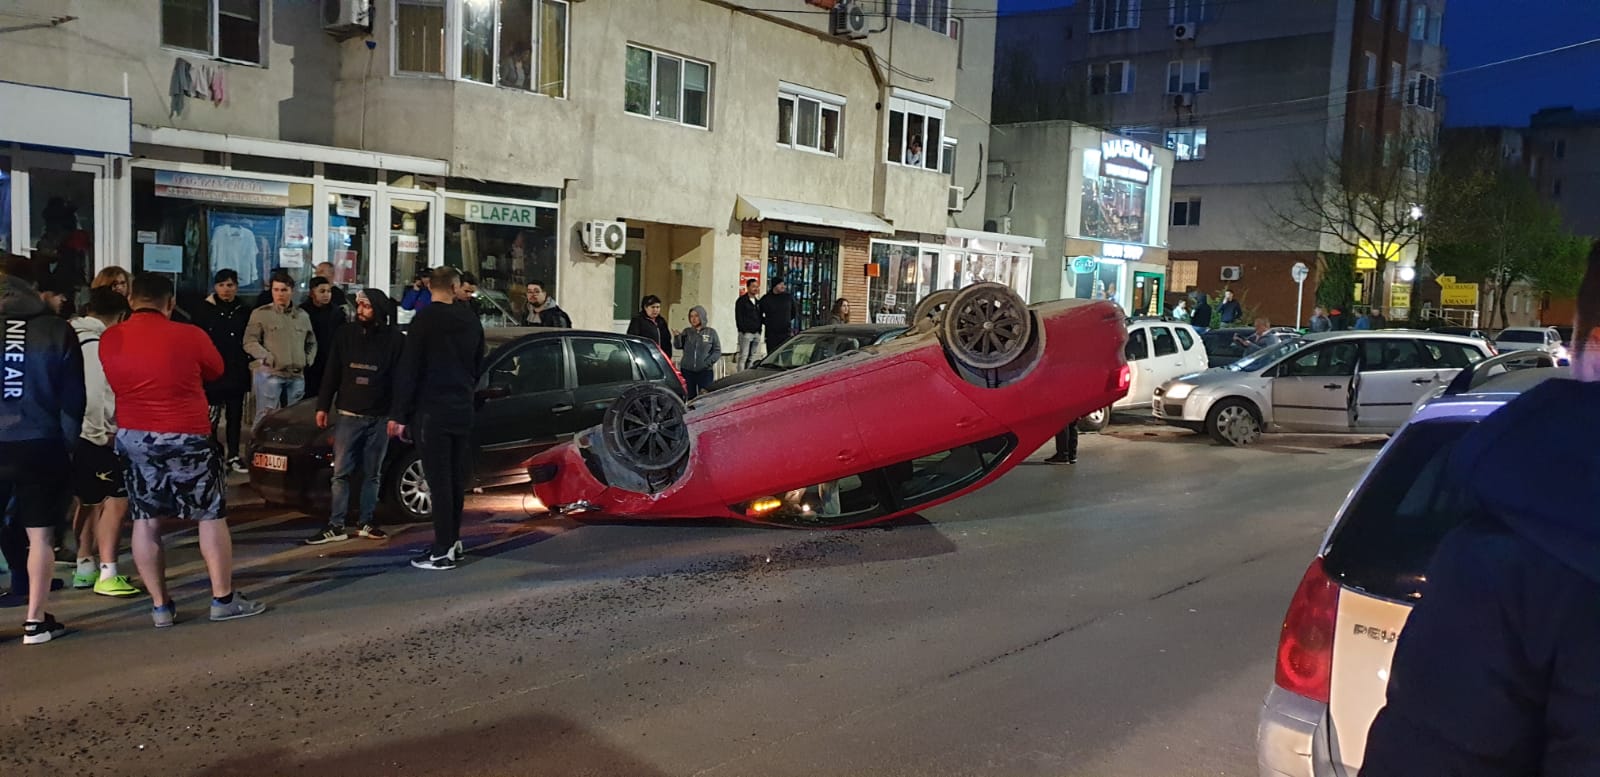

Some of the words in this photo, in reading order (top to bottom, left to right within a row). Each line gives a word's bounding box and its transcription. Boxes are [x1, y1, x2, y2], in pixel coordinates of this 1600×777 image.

[1102, 139, 1154, 171] MAGNUM
[470, 204, 531, 223] PLAFAR
[5, 320, 26, 362] NIKE
[4, 367, 24, 398] AIR
[1353, 624, 1399, 643] PEU
